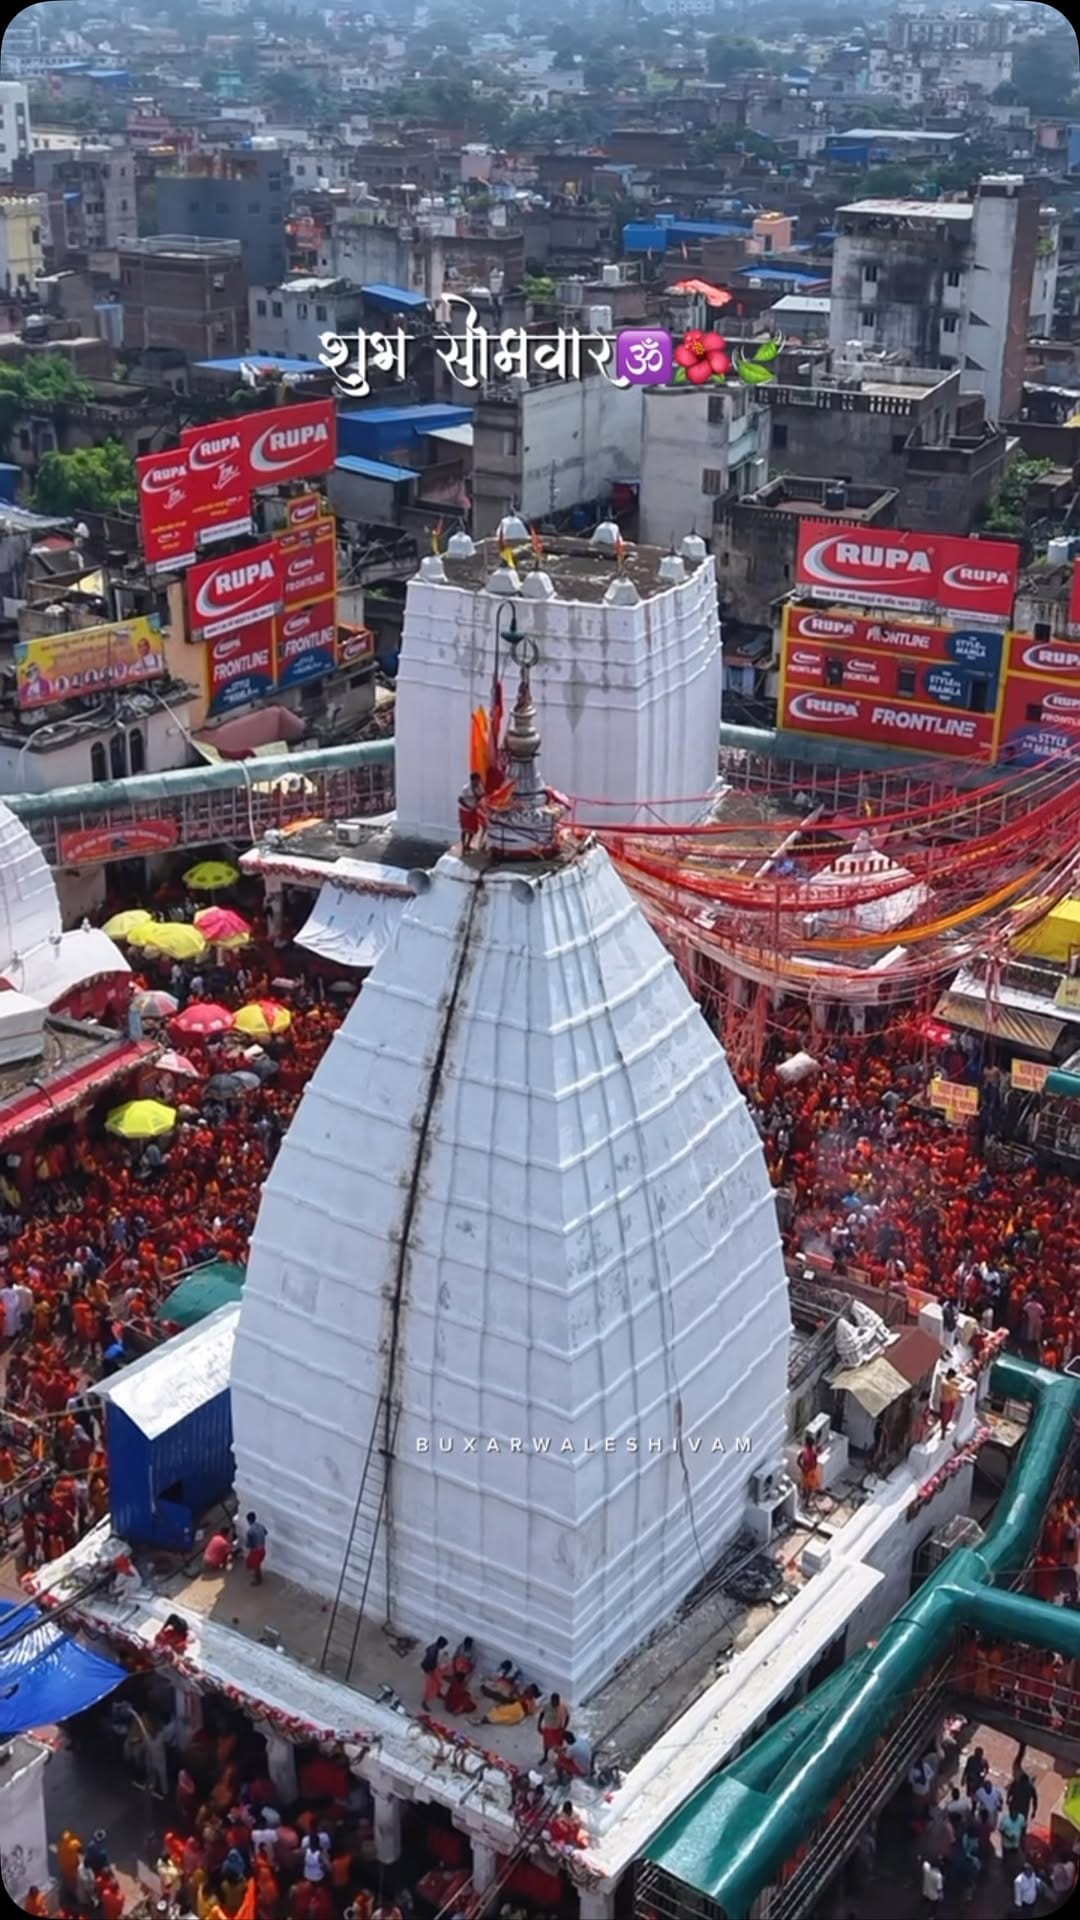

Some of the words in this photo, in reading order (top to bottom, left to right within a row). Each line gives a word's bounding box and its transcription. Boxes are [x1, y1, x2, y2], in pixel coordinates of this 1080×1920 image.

[200, 435, 241, 457] RUPA
[270, 423, 328, 451] RUPA
[152, 466, 187, 482] RUPA
[836, 542, 931, 573] RUPA
[215, 559, 275, 595] RUPA
[960, 567, 1009, 585] RUPA
[811, 619, 854, 635] RUPA
[284, 626, 334, 657] FRONTLINE
[212, 649, 269, 681] FRONTLINE
[1037, 649, 1080, 666] RUP
[805, 697, 858, 718] RUPA
[871, 707, 977, 738] FRONTLINE
